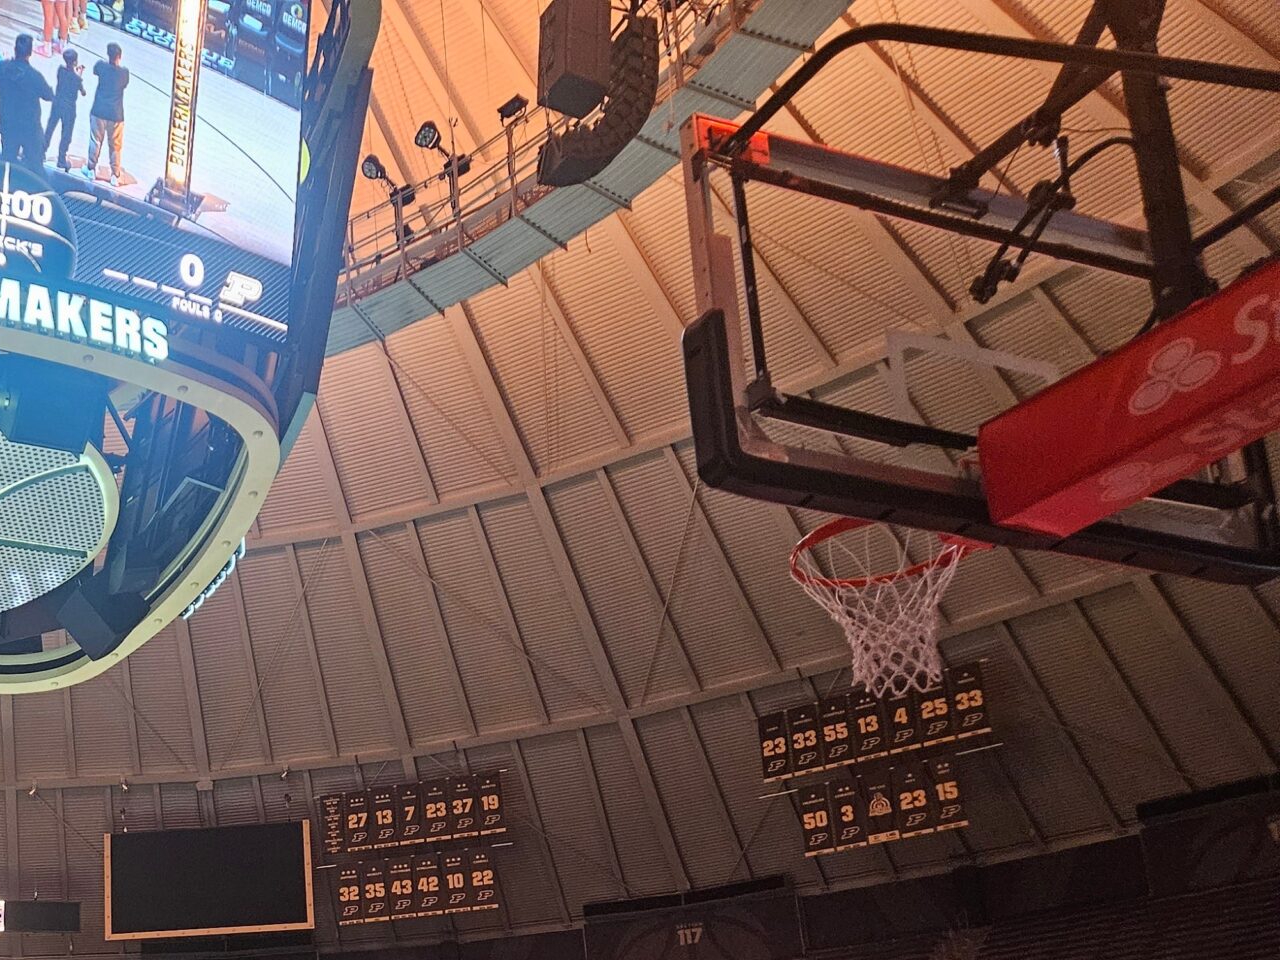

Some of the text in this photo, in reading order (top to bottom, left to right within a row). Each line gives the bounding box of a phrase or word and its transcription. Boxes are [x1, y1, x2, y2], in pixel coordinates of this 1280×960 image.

[170, 38, 194, 167] BOILERMAKERS
[180, 253, 205, 287] 0
[220, 271, 263, 306] P
[173, 296, 210, 319] FOULS
[921, 697, 948, 719] 25
[955, 689, 983, 710] 33
[857, 715, 879, 734] 13
[894, 707, 908, 725] 4
[793, 729, 817, 749] 33
[823, 722, 849, 742] 55
[762, 737, 786, 757] 23
[899, 789, 927, 810] 23
[935, 781, 959, 801] 15
[426, 802, 447, 818] 23
[452, 798, 472, 814] 37
[481, 794, 499, 811] 19
[348, 812, 367, 829] 27
[376, 809, 392, 825] 13
[405, 806, 415, 821] 7
[803, 810, 828, 830] 50
[840, 805, 854, 822] 3
[418, 876, 439, 893] 42
[446, 873, 464, 889] 10
[472, 870, 494, 886] 22
[339, 886, 360, 902] 32
[365, 883, 385, 898] 35
[391, 879, 412, 895] 43
[677, 928, 703, 945] 117
